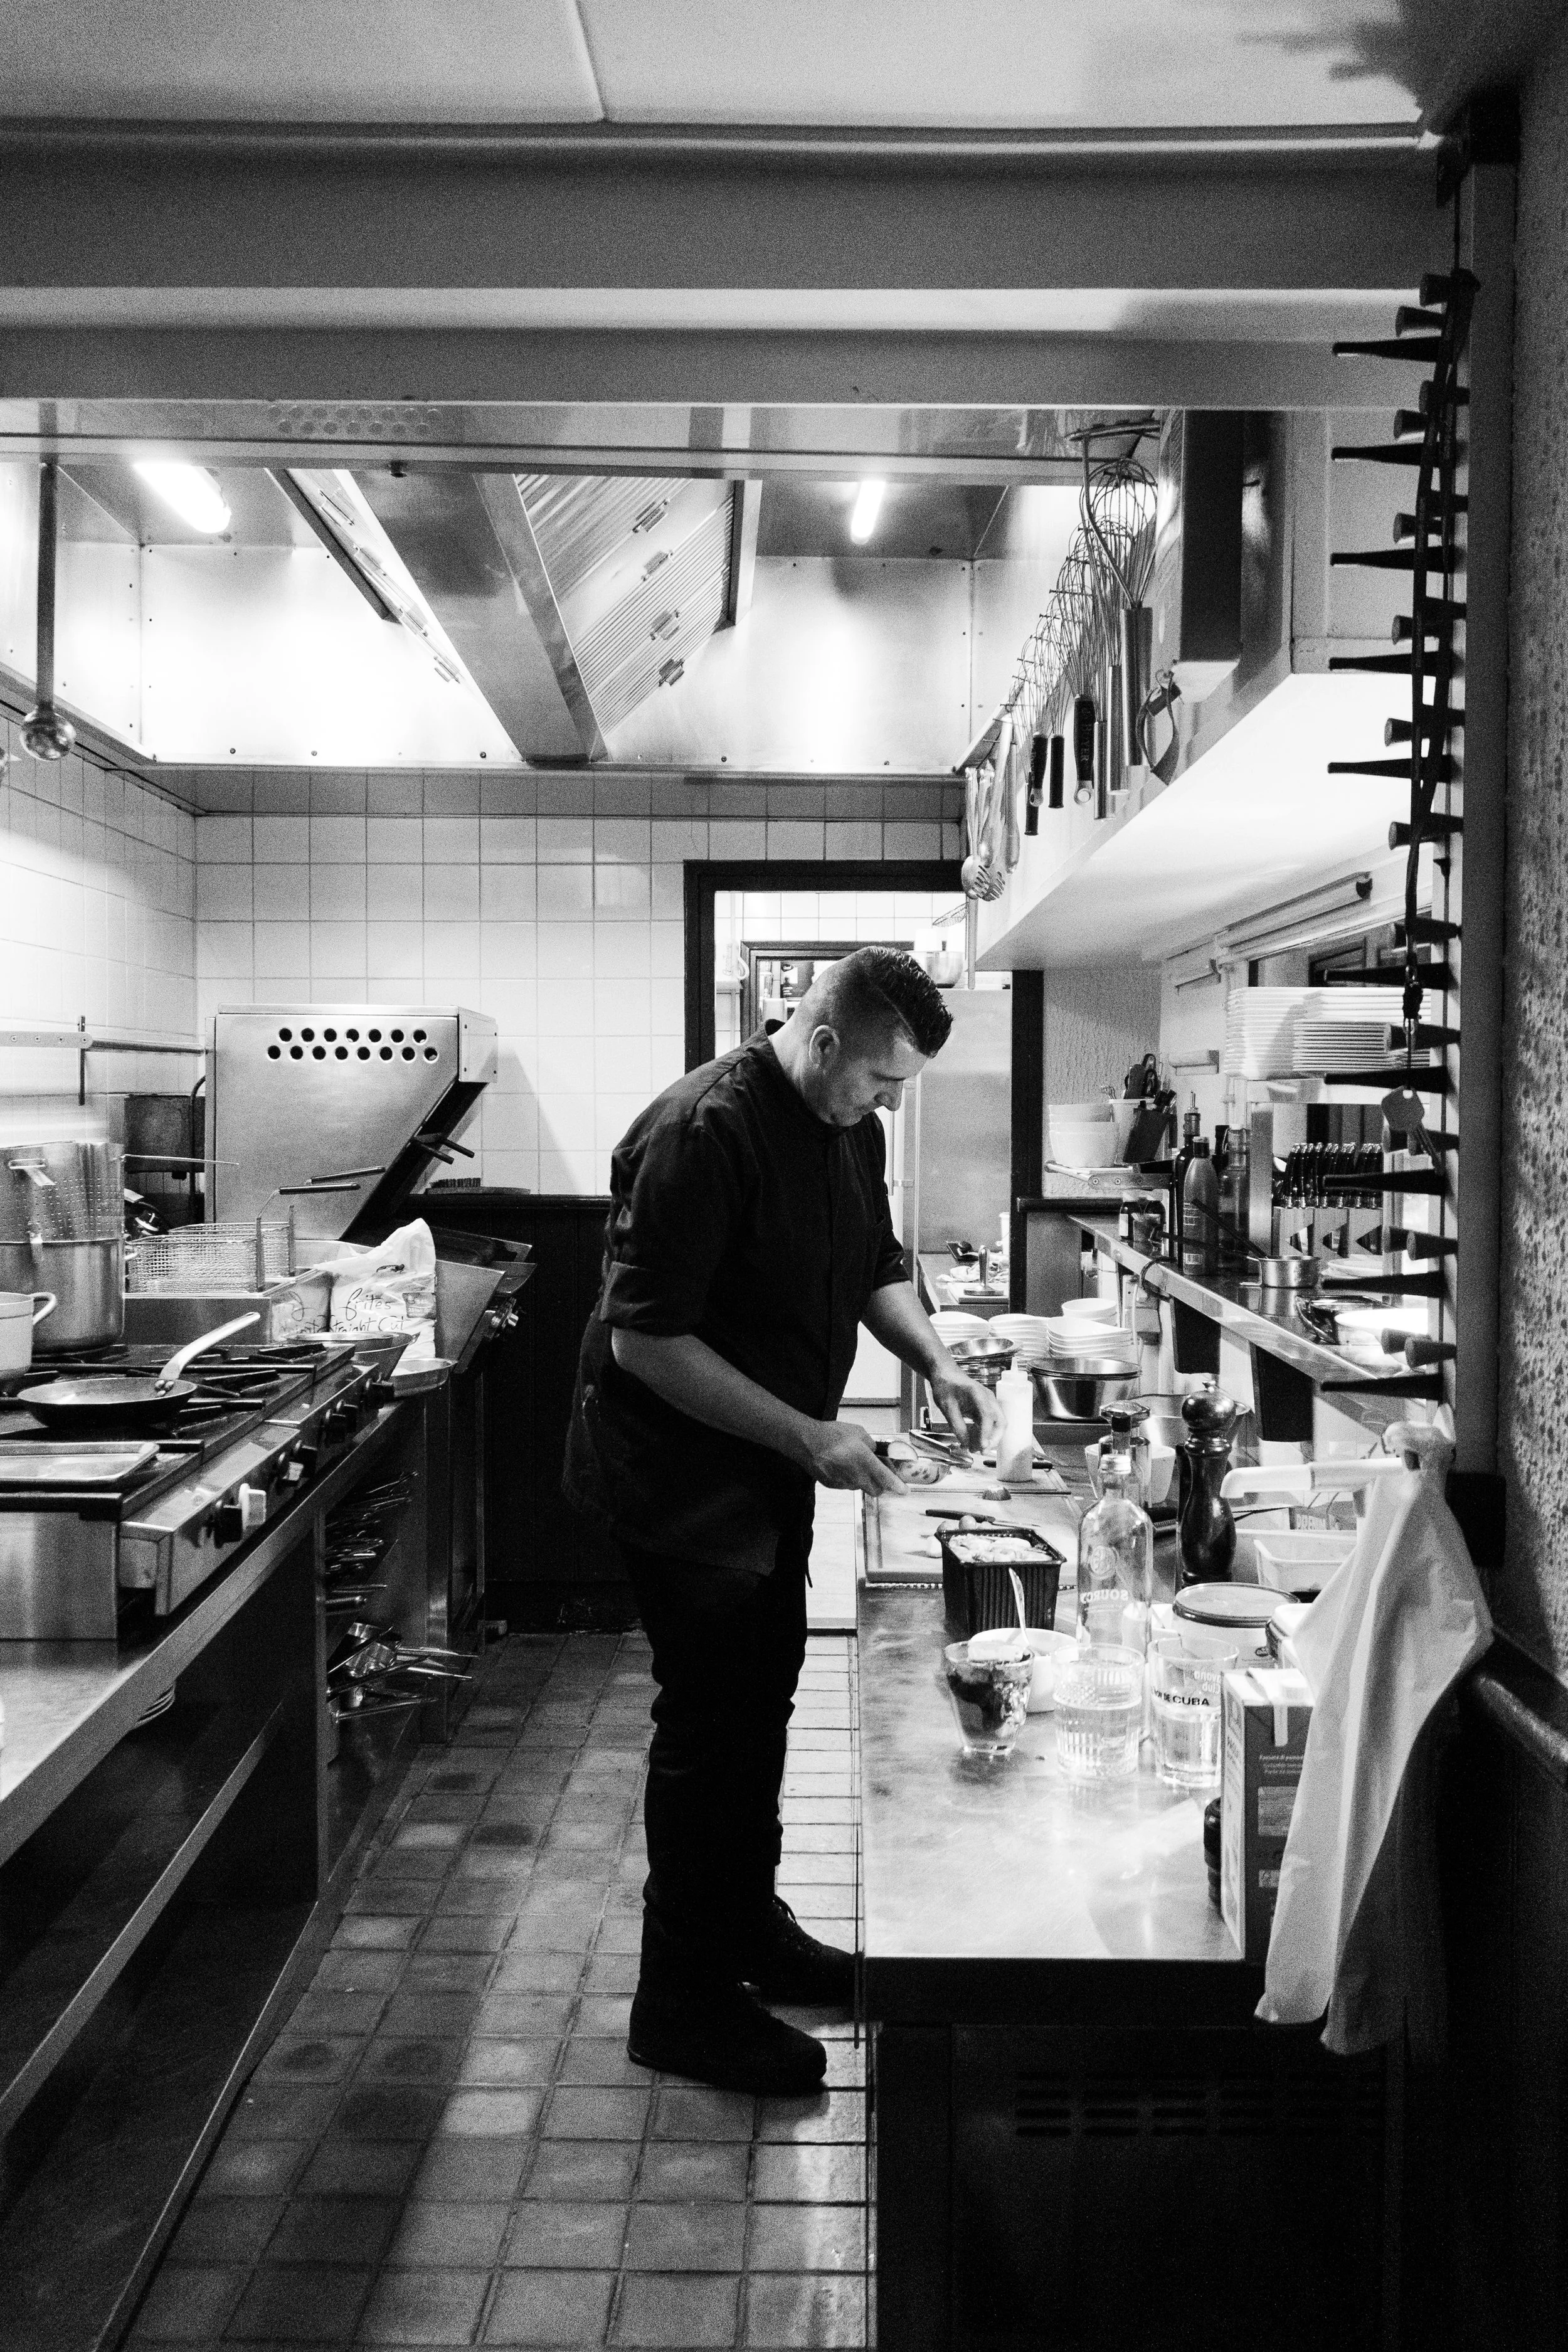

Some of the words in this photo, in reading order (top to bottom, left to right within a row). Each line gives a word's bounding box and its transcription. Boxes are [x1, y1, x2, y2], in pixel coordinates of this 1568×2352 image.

[337, 1288, 391, 1320] frites
[331, 1315, 377, 1332] traight
[378, 1315, 411, 1332] Cut
[1172, 1695, 1210, 1706] CUBA
